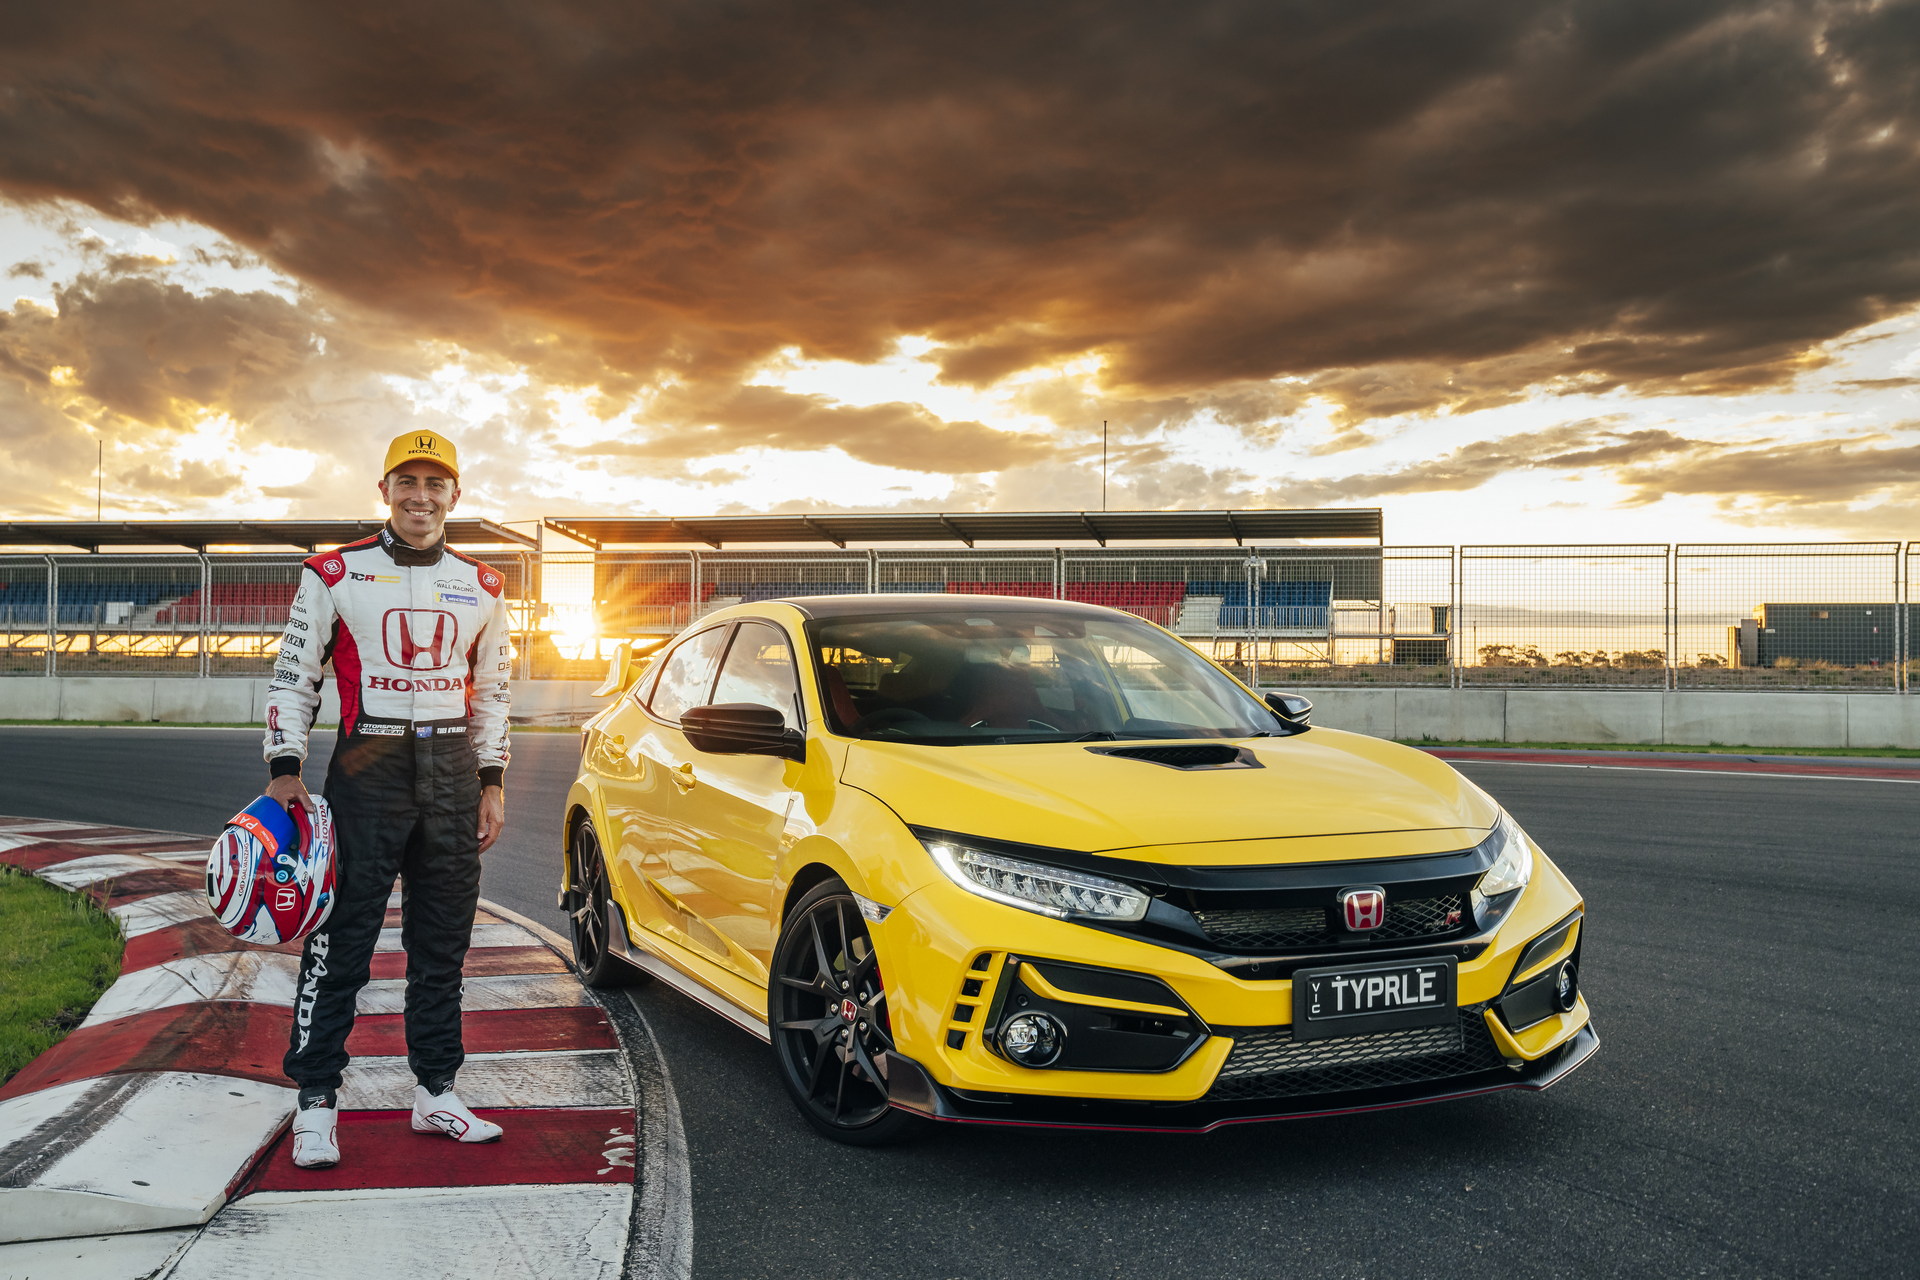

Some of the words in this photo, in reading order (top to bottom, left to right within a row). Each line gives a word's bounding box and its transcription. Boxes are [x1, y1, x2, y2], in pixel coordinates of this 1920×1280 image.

[408, 449, 441, 458] HONDA
[349, 571, 376, 582] TCR
[452, 585, 474, 593] RACING
[447, 596, 476, 604] MICHELIN
[367, 675, 464, 693] HONDA
[319, 804, 329, 845] HONDA
[296, 932, 329, 1054] HONDA
[1311, 982, 1321, 1014] VIC
[1331, 971, 1437, 1011] TYPRLE
